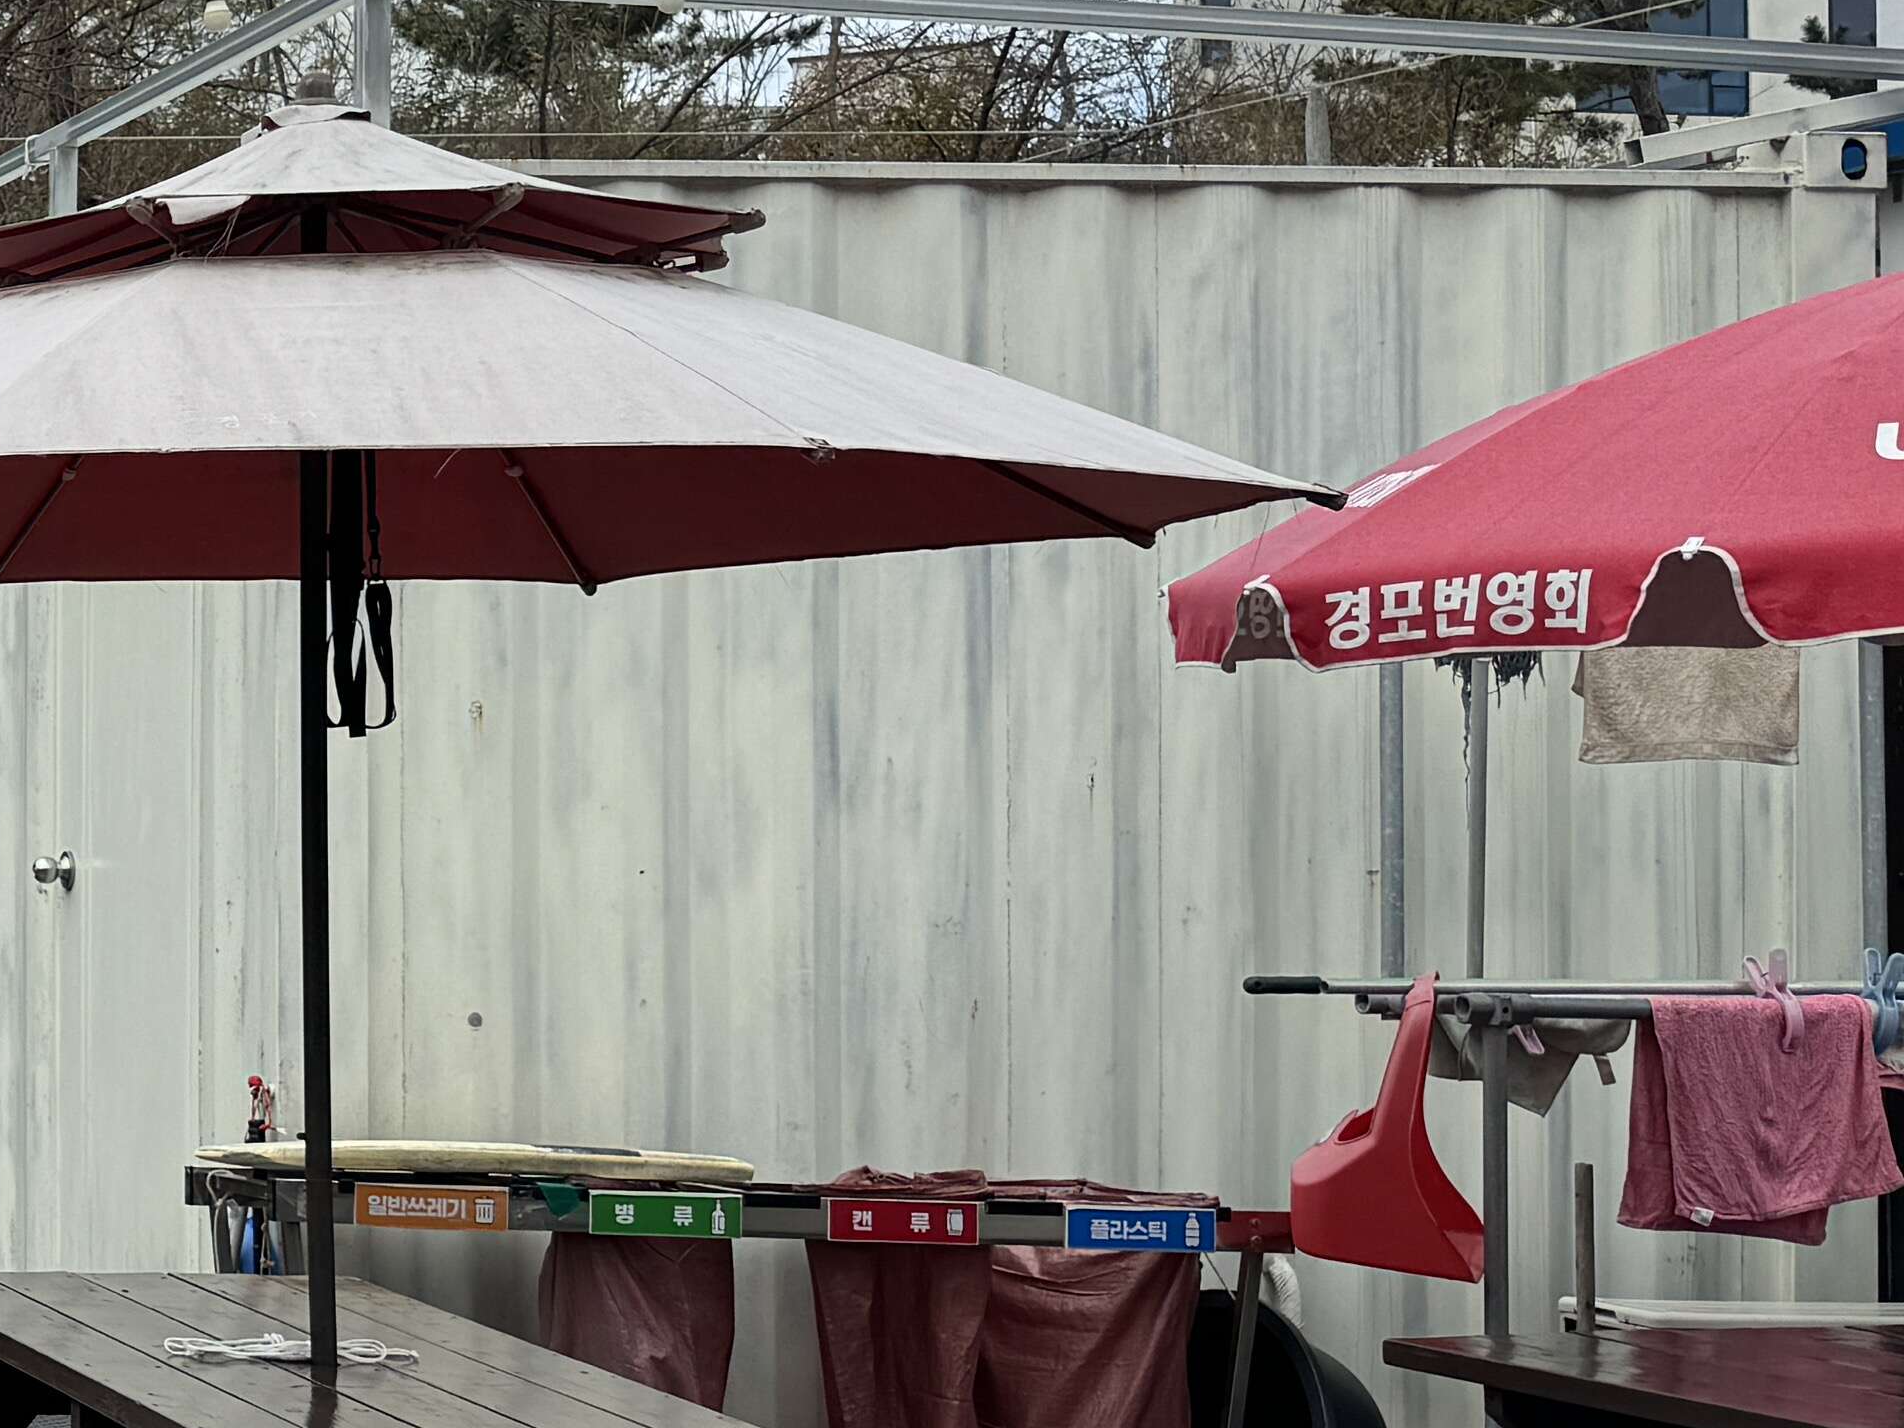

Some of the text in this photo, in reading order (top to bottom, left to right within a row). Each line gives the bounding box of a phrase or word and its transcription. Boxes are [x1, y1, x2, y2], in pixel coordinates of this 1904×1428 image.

[1324, 568, 1593, 650] 경포번영회
[368, 1195, 467, 1220] 일반쓰레기
[1090, 1219, 1167, 1242] 플라스틱
